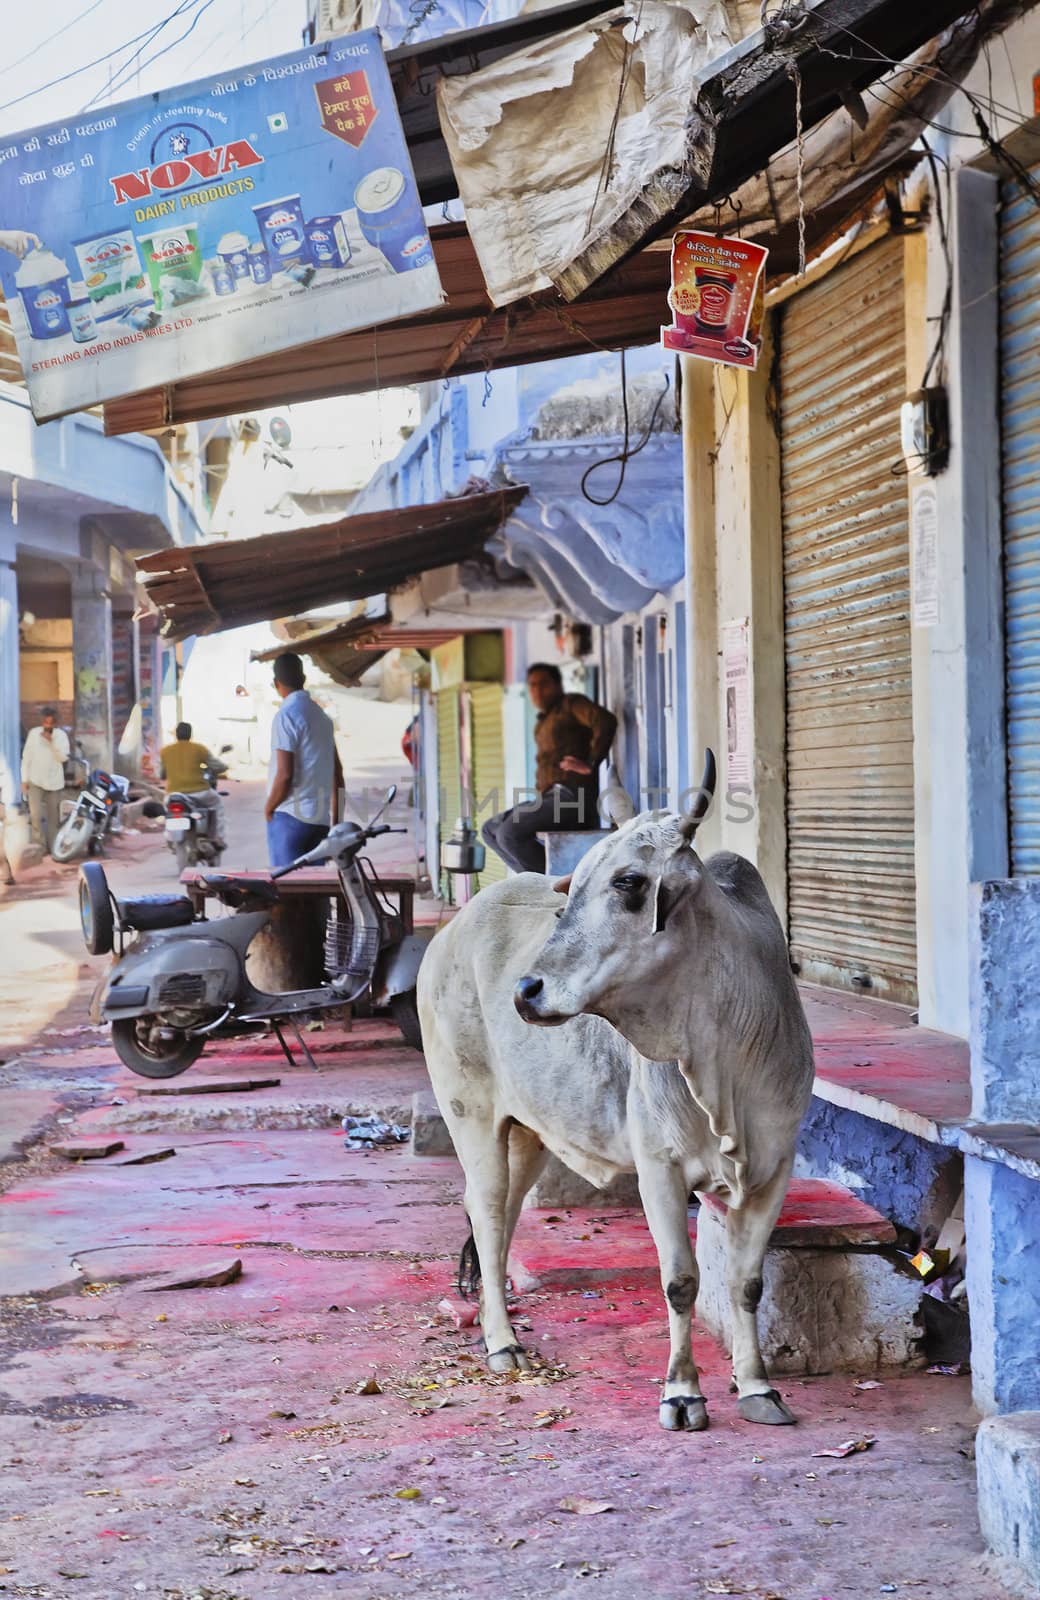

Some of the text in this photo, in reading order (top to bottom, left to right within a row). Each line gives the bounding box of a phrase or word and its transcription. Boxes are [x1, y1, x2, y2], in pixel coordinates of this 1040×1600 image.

[211, 80, 239, 97] नोवा
[244, 73, 257, 88] के
[333, 43, 370, 62] उत्पाद
[23, 136, 41, 152] की
[46, 127, 71, 146] सही
[75, 116, 118, 137] पहचान
[18, 170, 47, 185] नोवा
[80, 153, 95, 168] घी
[109, 138, 265, 206] NOVA
[134, 176, 255, 224] DAIRY PRODUCTS
[32, 351, 82, 373] STERLING
[83, 341, 112, 358] AGRO
